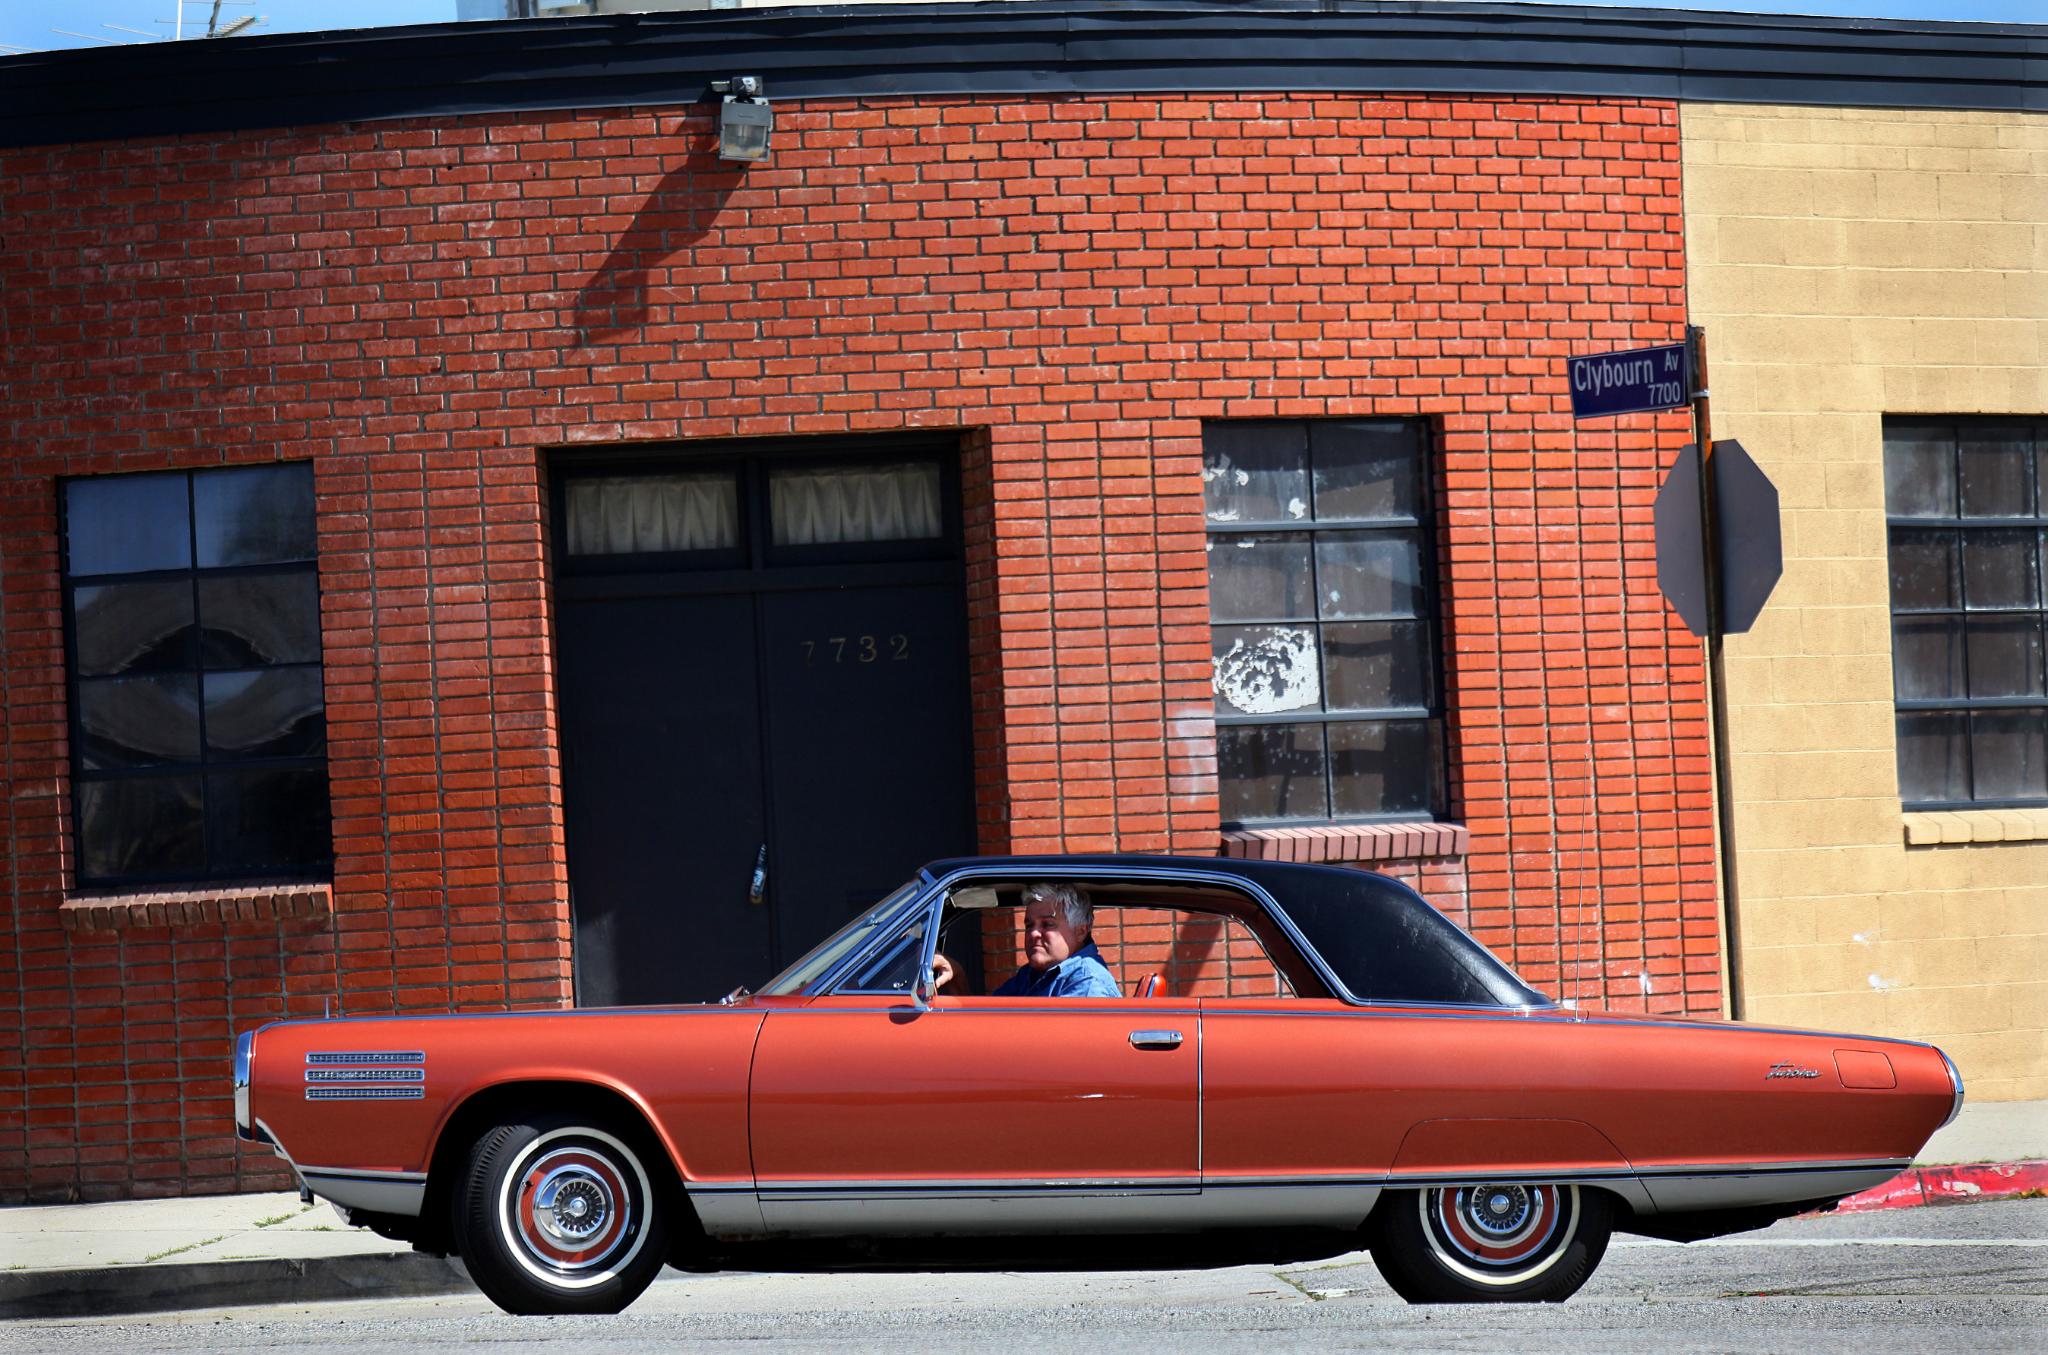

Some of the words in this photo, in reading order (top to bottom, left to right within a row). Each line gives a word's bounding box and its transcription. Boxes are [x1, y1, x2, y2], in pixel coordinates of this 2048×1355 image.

[1574, 359, 1653, 396] Clybourn
[1664, 351, 1679, 372] Av
[1648, 381, 1681, 405] 7700
[800, 634, 908, 666] 7732
